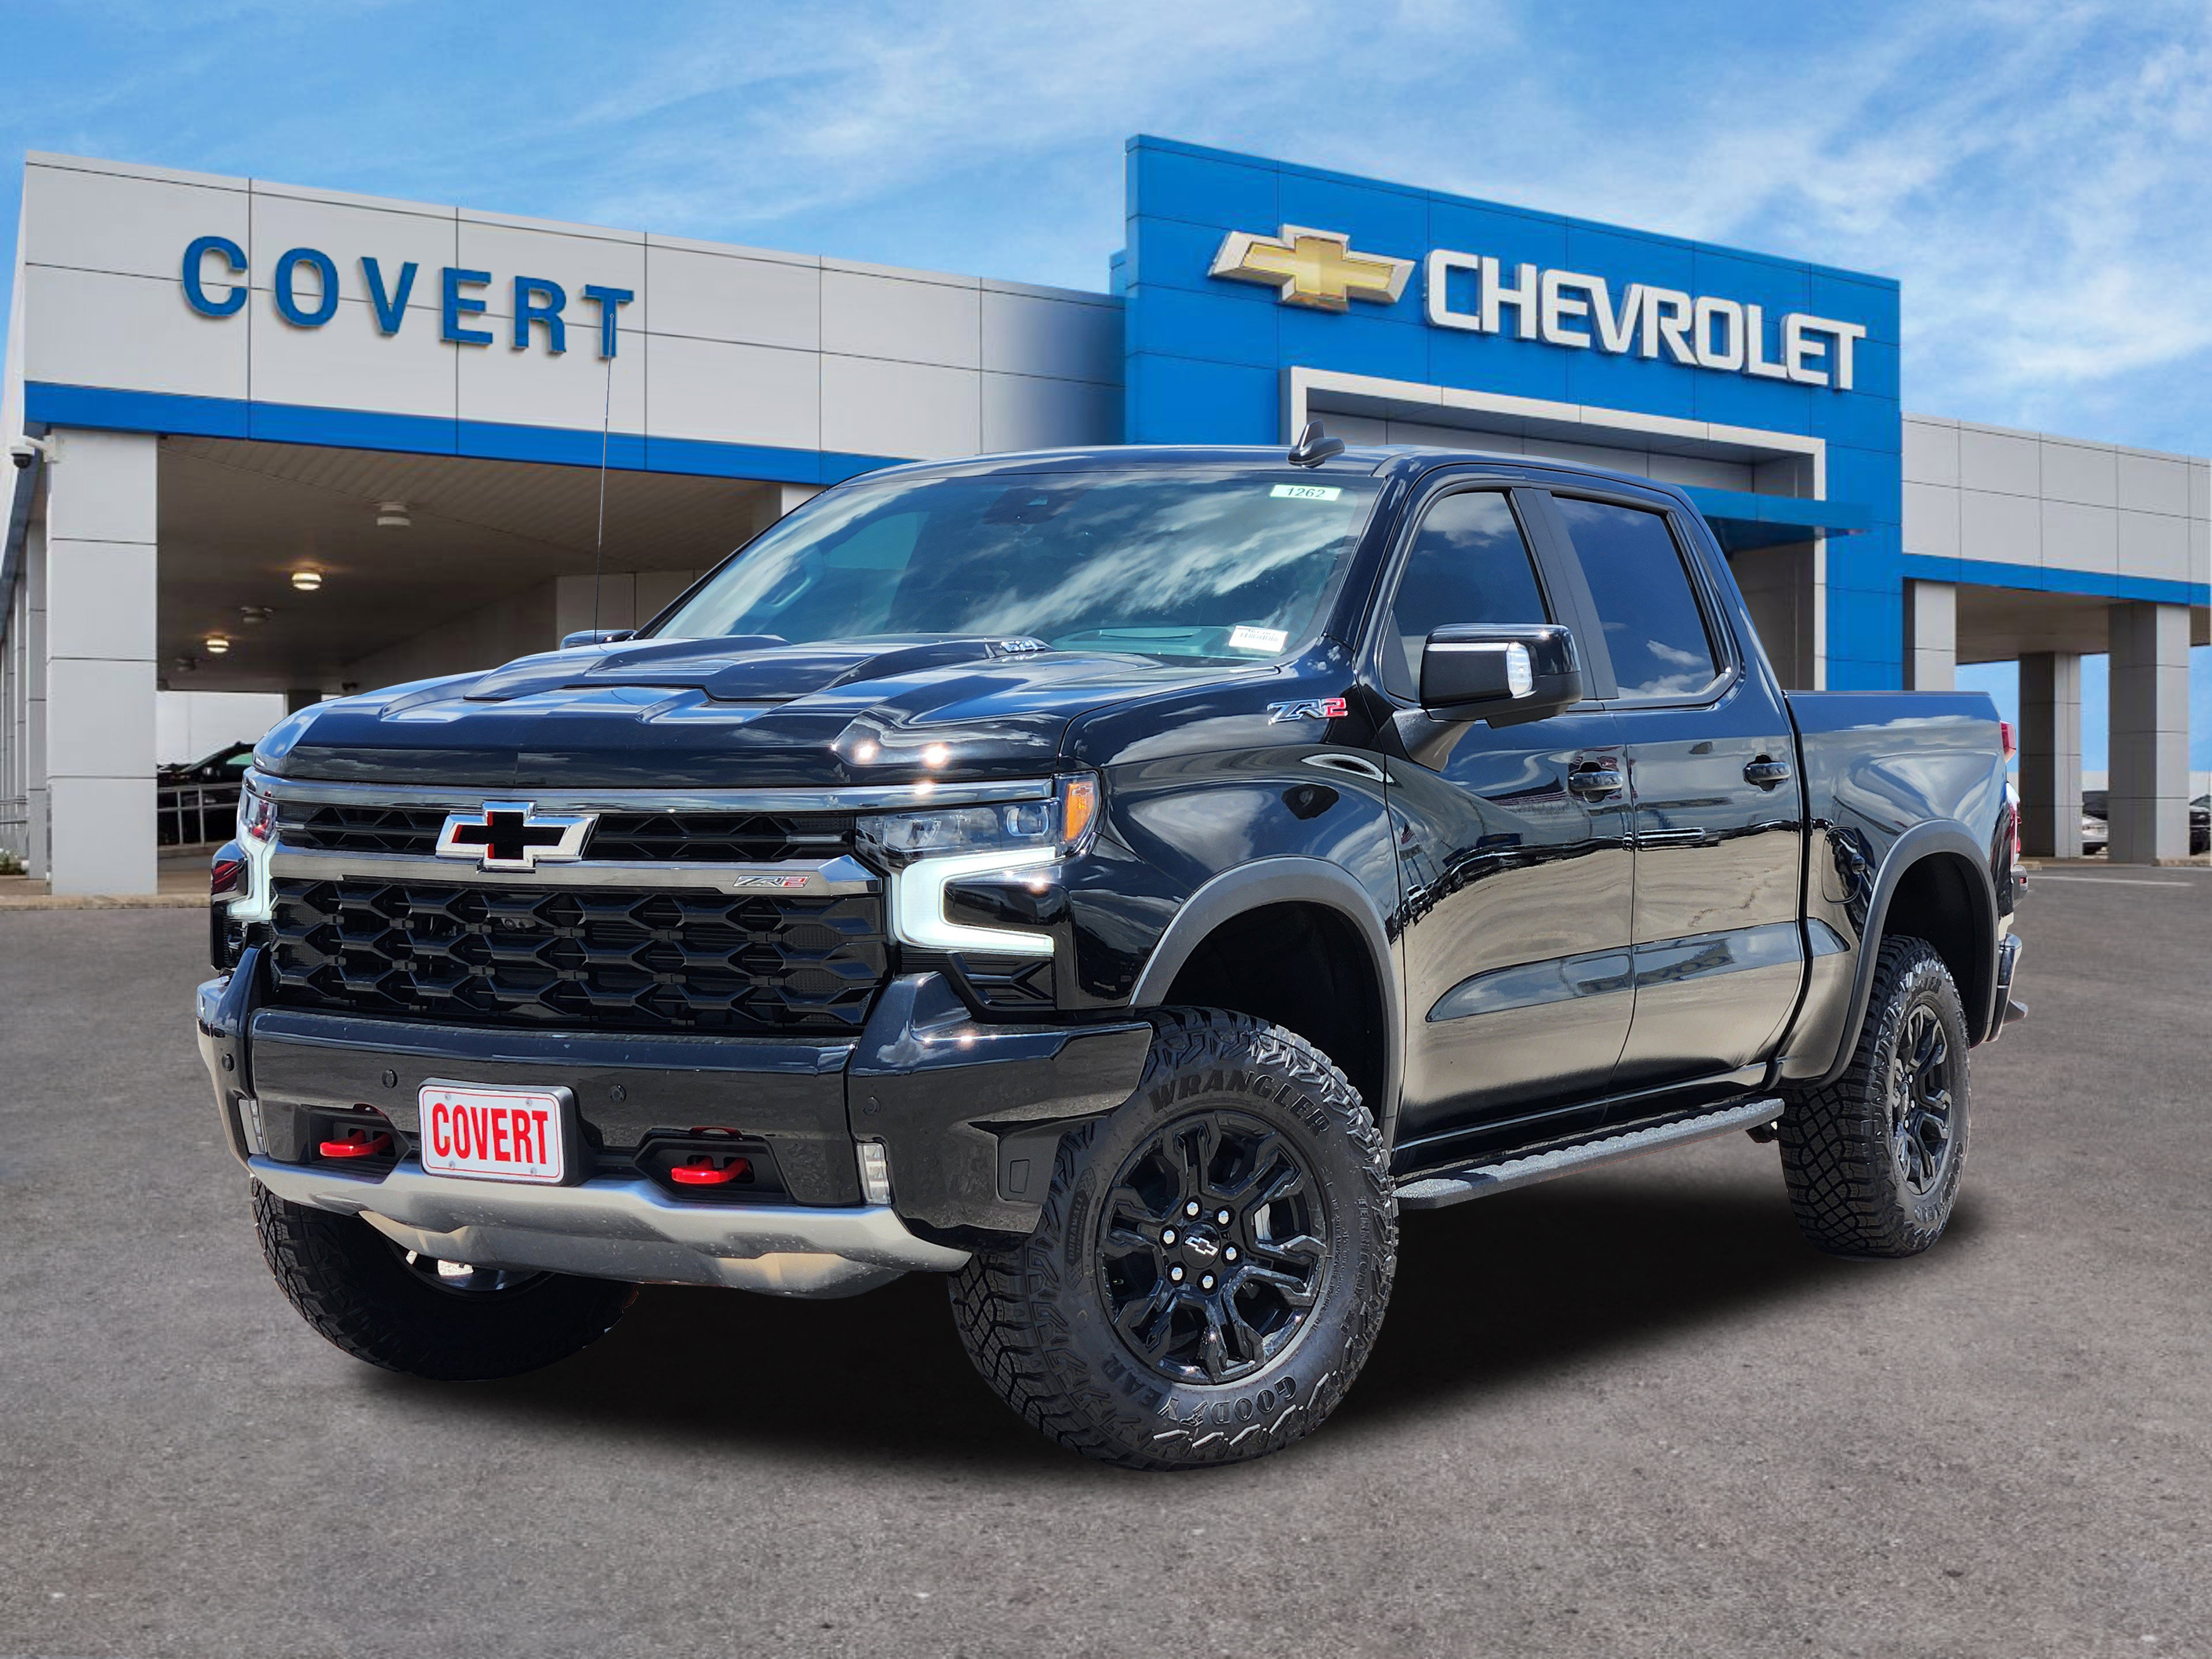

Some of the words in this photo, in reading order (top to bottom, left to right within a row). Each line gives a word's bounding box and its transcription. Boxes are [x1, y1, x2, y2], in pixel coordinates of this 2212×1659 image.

[182, 236, 634, 359] COVERT
[1423, 249, 1866, 390] CHEVROLET
[1287, 487, 1326, 498] 1262
[1267, 698, 1348, 725] ZR2
[732, 875, 810, 888] ZR2
[432, 1103, 548, 1165] COVERT
[1149, 1068, 1331, 1138] WRANGLER
[1101, 1352, 1297, 1427] GOODYEAR
